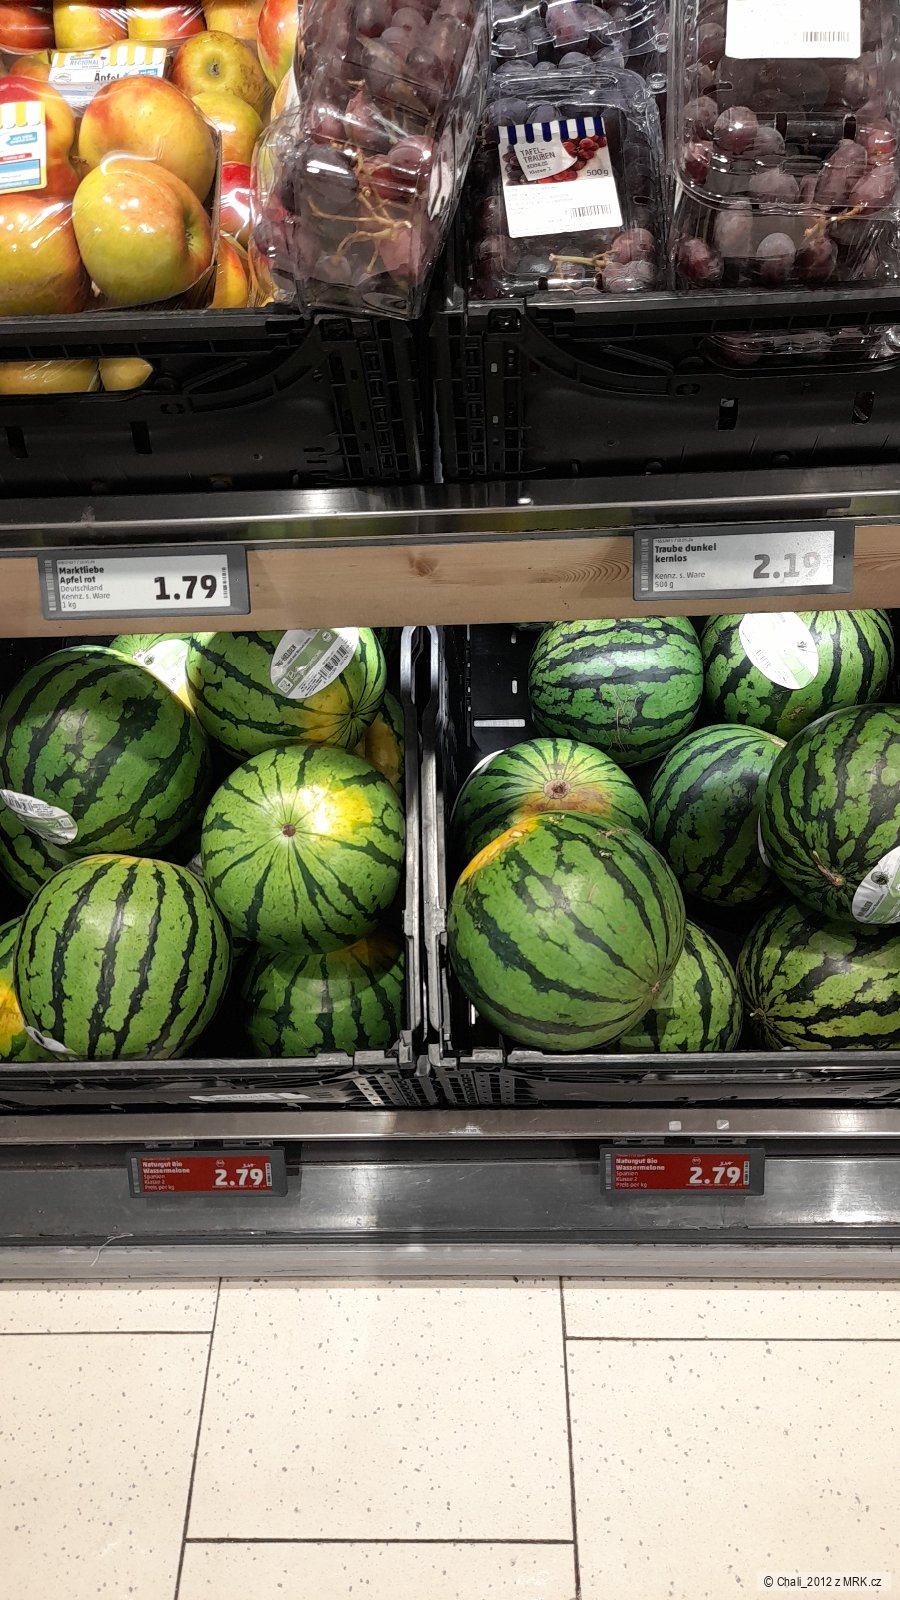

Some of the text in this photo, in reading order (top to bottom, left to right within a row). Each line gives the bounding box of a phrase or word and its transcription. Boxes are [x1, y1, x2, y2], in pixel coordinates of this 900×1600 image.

[519, 147, 546, 156] TAFEL-
[523, 151, 556, 164] TRAUBEN
[655, 542, 717, 553] Traube dunkel
[655, 554, 688, 563] kernlos
[59, 566, 104, 574] Marktliebe
[753, 551, 821, 579] 2.19
[686, 571, 706, 579] Ware
[60, 576, 82, 585] Apfel
[60, 584, 103, 592] Deutschland
[154, 574, 217, 600] 1.79
[214, 1168, 264, 1186] 2.79
[689, 1166, 741, 1184] 2.79
